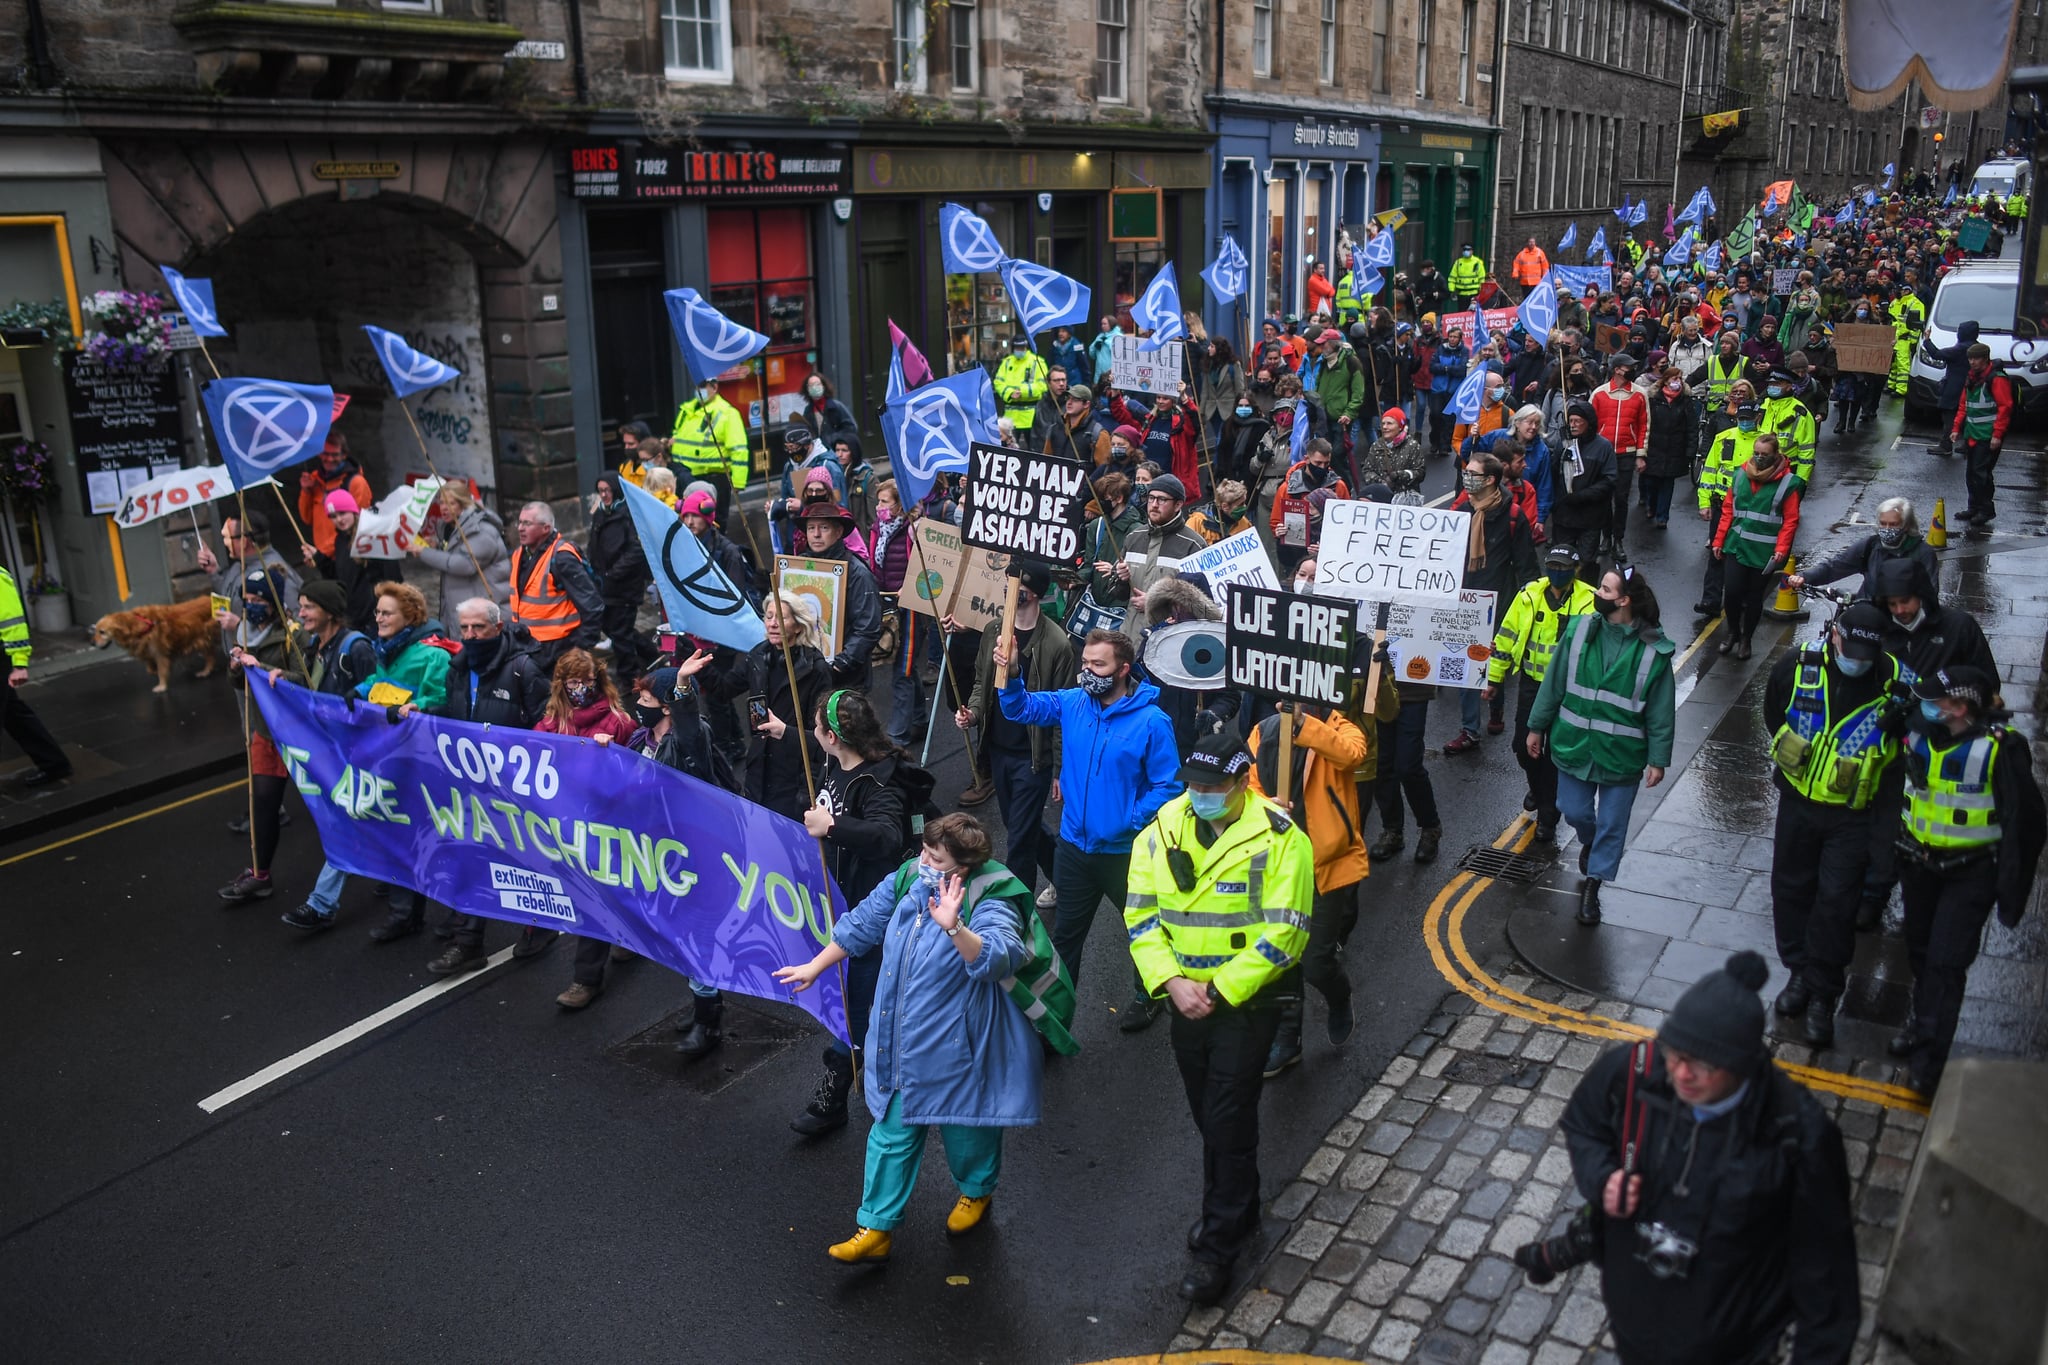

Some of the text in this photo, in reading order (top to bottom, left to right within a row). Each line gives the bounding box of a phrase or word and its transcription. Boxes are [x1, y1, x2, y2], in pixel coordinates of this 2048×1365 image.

[1294, 123, 1359, 148] Simply Scottish
[573, 148, 617, 171] BENE'S
[690, 152, 776, 182] BENE'S
[781, 159, 841, 173] HOME DELIVERY
[645, 186, 682, 197] ONLINE
[1114, 375, 1137, 385] YSTEM
[977, 450, 1085, 496] YER MAW
[132, 479, 214, 523] STOP
[973, 481, 1070, 524] WOULD BE
[1331, 503, 1459, 533] CARBON
[356, 513, 414, 556] STOP
[925, 527, 963, 552] GREEN
[968, 510, 1077, 560] ASHAMED
[1347, 531, 1449, 561] FREE
[927, 554, 954, 568] IS THE
[1196, 548, 1223, 573] WORLD
[1221, 532, 1258, 561] LEADERS
[1214, 568, 1227, 579] NOT
[1320, 560, 1456, 593] SCOTLAND
[971, 595, 1004, 618] BLAC
[1233, 592, 1349, 649] WE ARE
[1431, 616, 1480, 627] EDINBURGH
[1852, 628, 1880, 640] POLICE
[1232, 645, 1345, 704] WATCHING
[436, 733, 559, 800] COP26
[1191, 752, 1220, 766] POLICE
[330, 763, 411, 825] ARE
[421, 782, 698, 897] WATCHING
[721, 852, 836, 948] YOU
[495, 867, 554, 893] extinction
[1217, 883, 1245, 892] POLICE
[516, 893, 572, 919] rebellion
